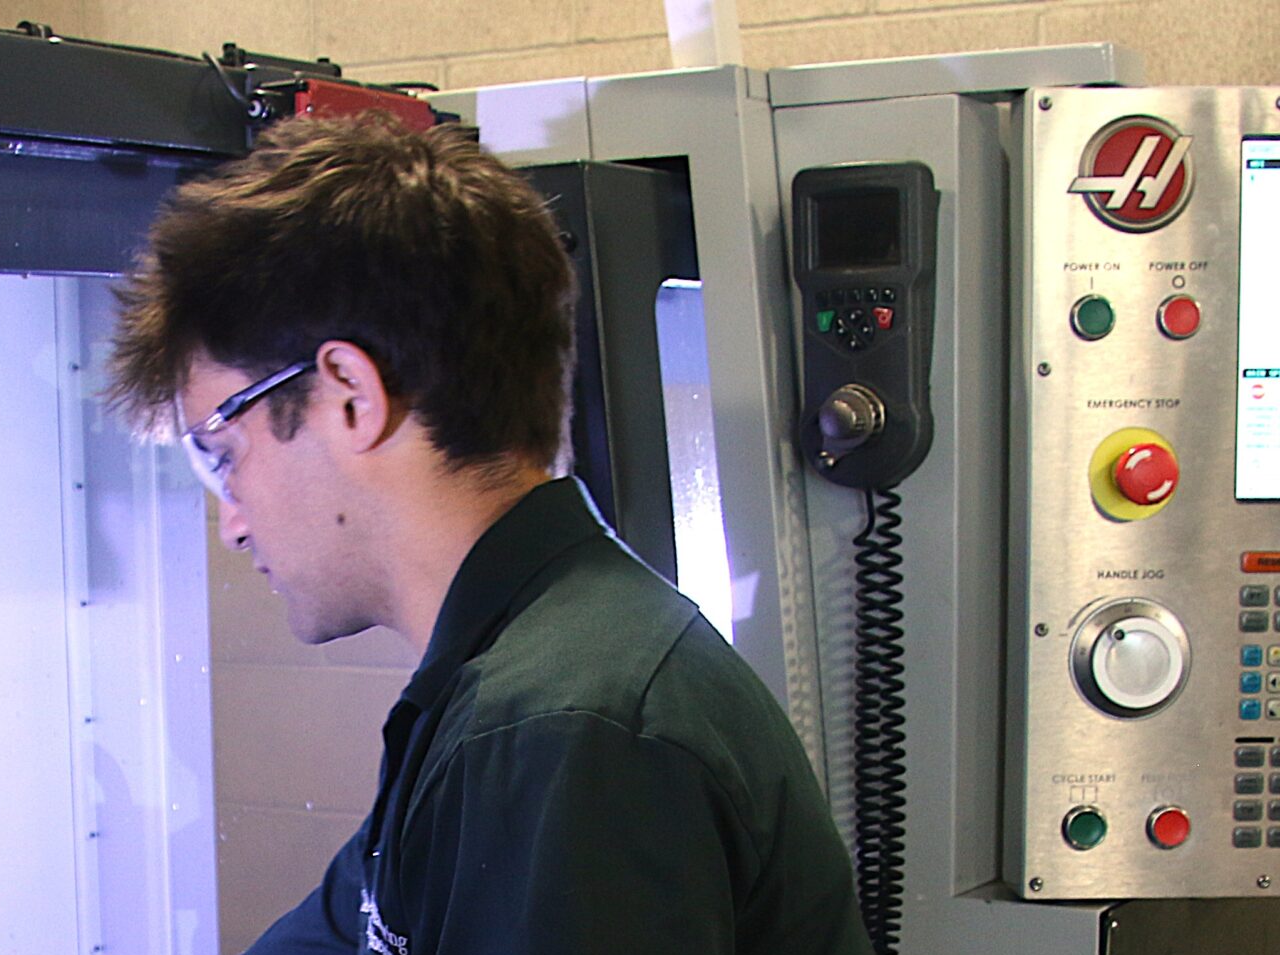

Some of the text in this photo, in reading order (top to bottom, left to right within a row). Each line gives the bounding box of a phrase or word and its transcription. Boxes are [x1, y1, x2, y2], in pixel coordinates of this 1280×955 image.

[1063, 262, 1100, 271] POWER
[1148, 261, 1208, 271] POWER OFF
[1087, 399, 1181, 409] EMERGENCY STOP
[1097, 569, 1165, 580] HANDLE JOG
[1051, 773, 1116, 784] CYCLE START
